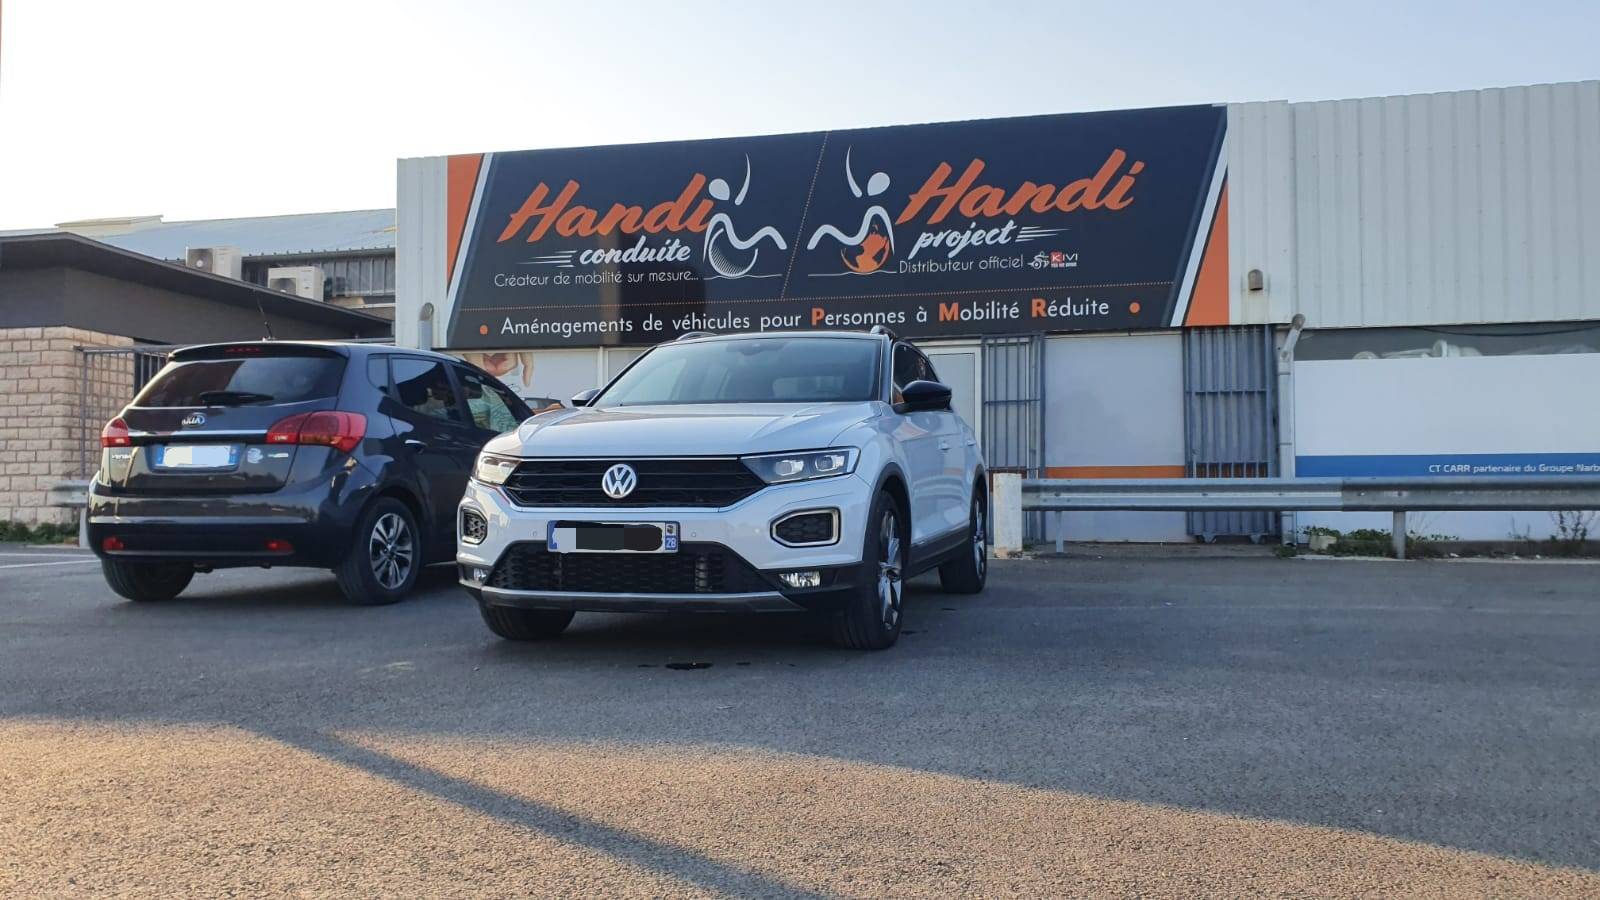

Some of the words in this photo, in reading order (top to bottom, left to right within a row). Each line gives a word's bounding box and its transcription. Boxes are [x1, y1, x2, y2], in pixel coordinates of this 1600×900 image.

[895, 148, 1145, 226] Handi
[497, 172, 714, 242] Handi
[579, 235, 691, 265] conduite
[907, 219, 1017, 260] project
[899, 258, 974, 273] Distributeur
[978, 254, 1024, 270] officiel
[1052, 253, 1078, 262] KIVI
[494, 273, 548, 287] Créateur
[553, 272, 570, 285] de
[575, 270, 622, 284] mobilité
[627, 272, 644, 283] sur
[501, 316, 633, 337] Aménagements
[642, 314, 663, 332] de
[672, 312, 750, 330] véhicules
[760, 314, 801, 332] pour
[811, 307, 905, 326] Personnes
[916, 306, 928, 323] à
[938, 302, 1020, 322] Mobilité
[1031, 298, 1109, 318] Réduite
[1428, 464, 1441, 473] CT
[1443, 464, 1471, 473] CARR
[1473, 464, 1521, 474] partenaire
[1523, 463, 1537, 472] du
[1538, 463, 1574, 474] Groupe
